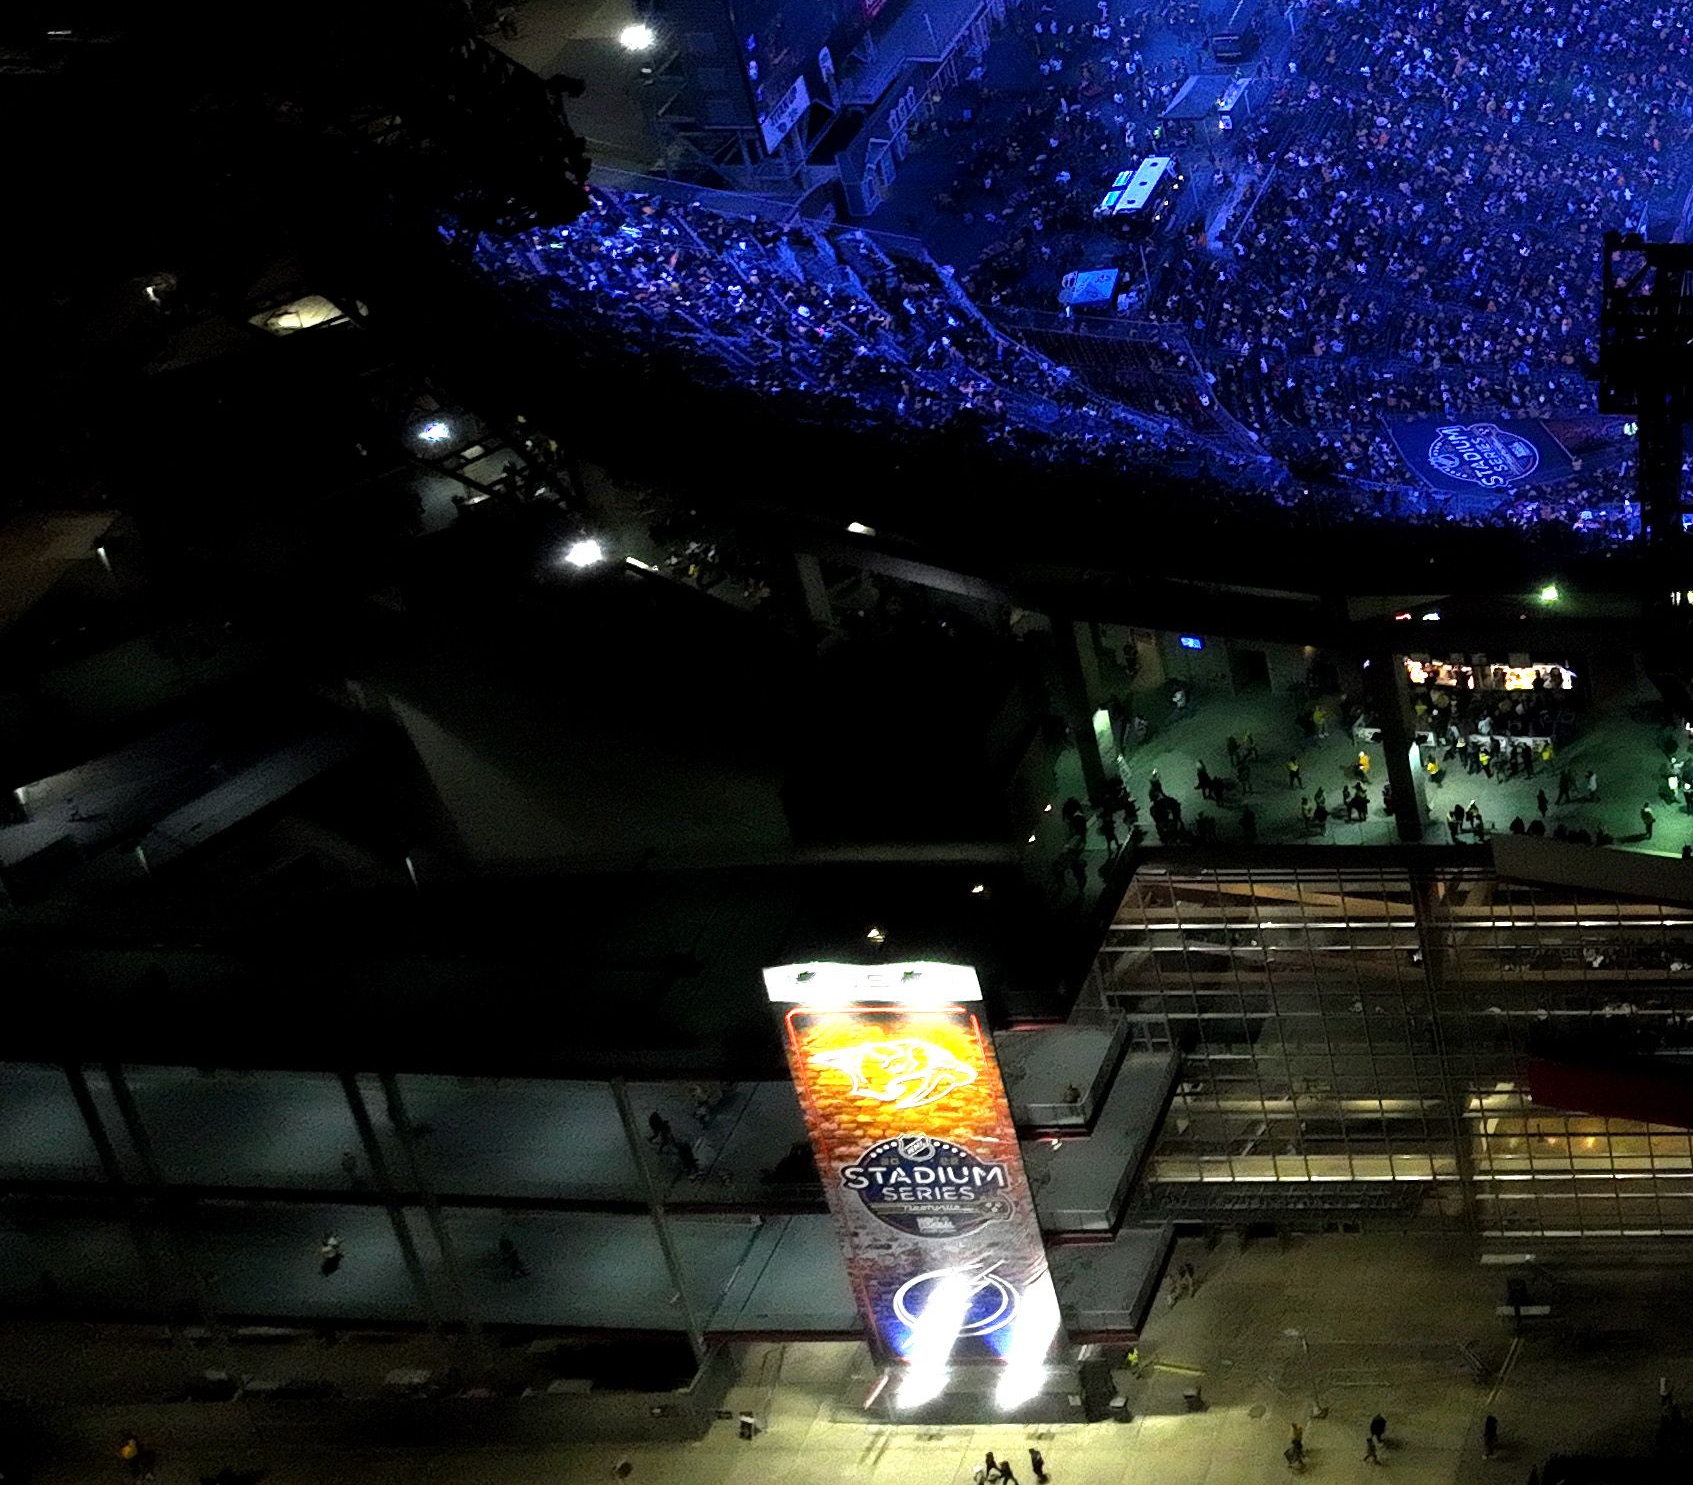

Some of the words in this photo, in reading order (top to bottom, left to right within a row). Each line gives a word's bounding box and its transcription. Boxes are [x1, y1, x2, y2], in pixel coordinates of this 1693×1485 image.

[1440, 427, 1505, 486] STADIUM
[1471, 437, 1509, 472] SERIES
[844, 1166, 1006, 1190] STADIUM
[881, 1186, 975, 1202] SERIES
